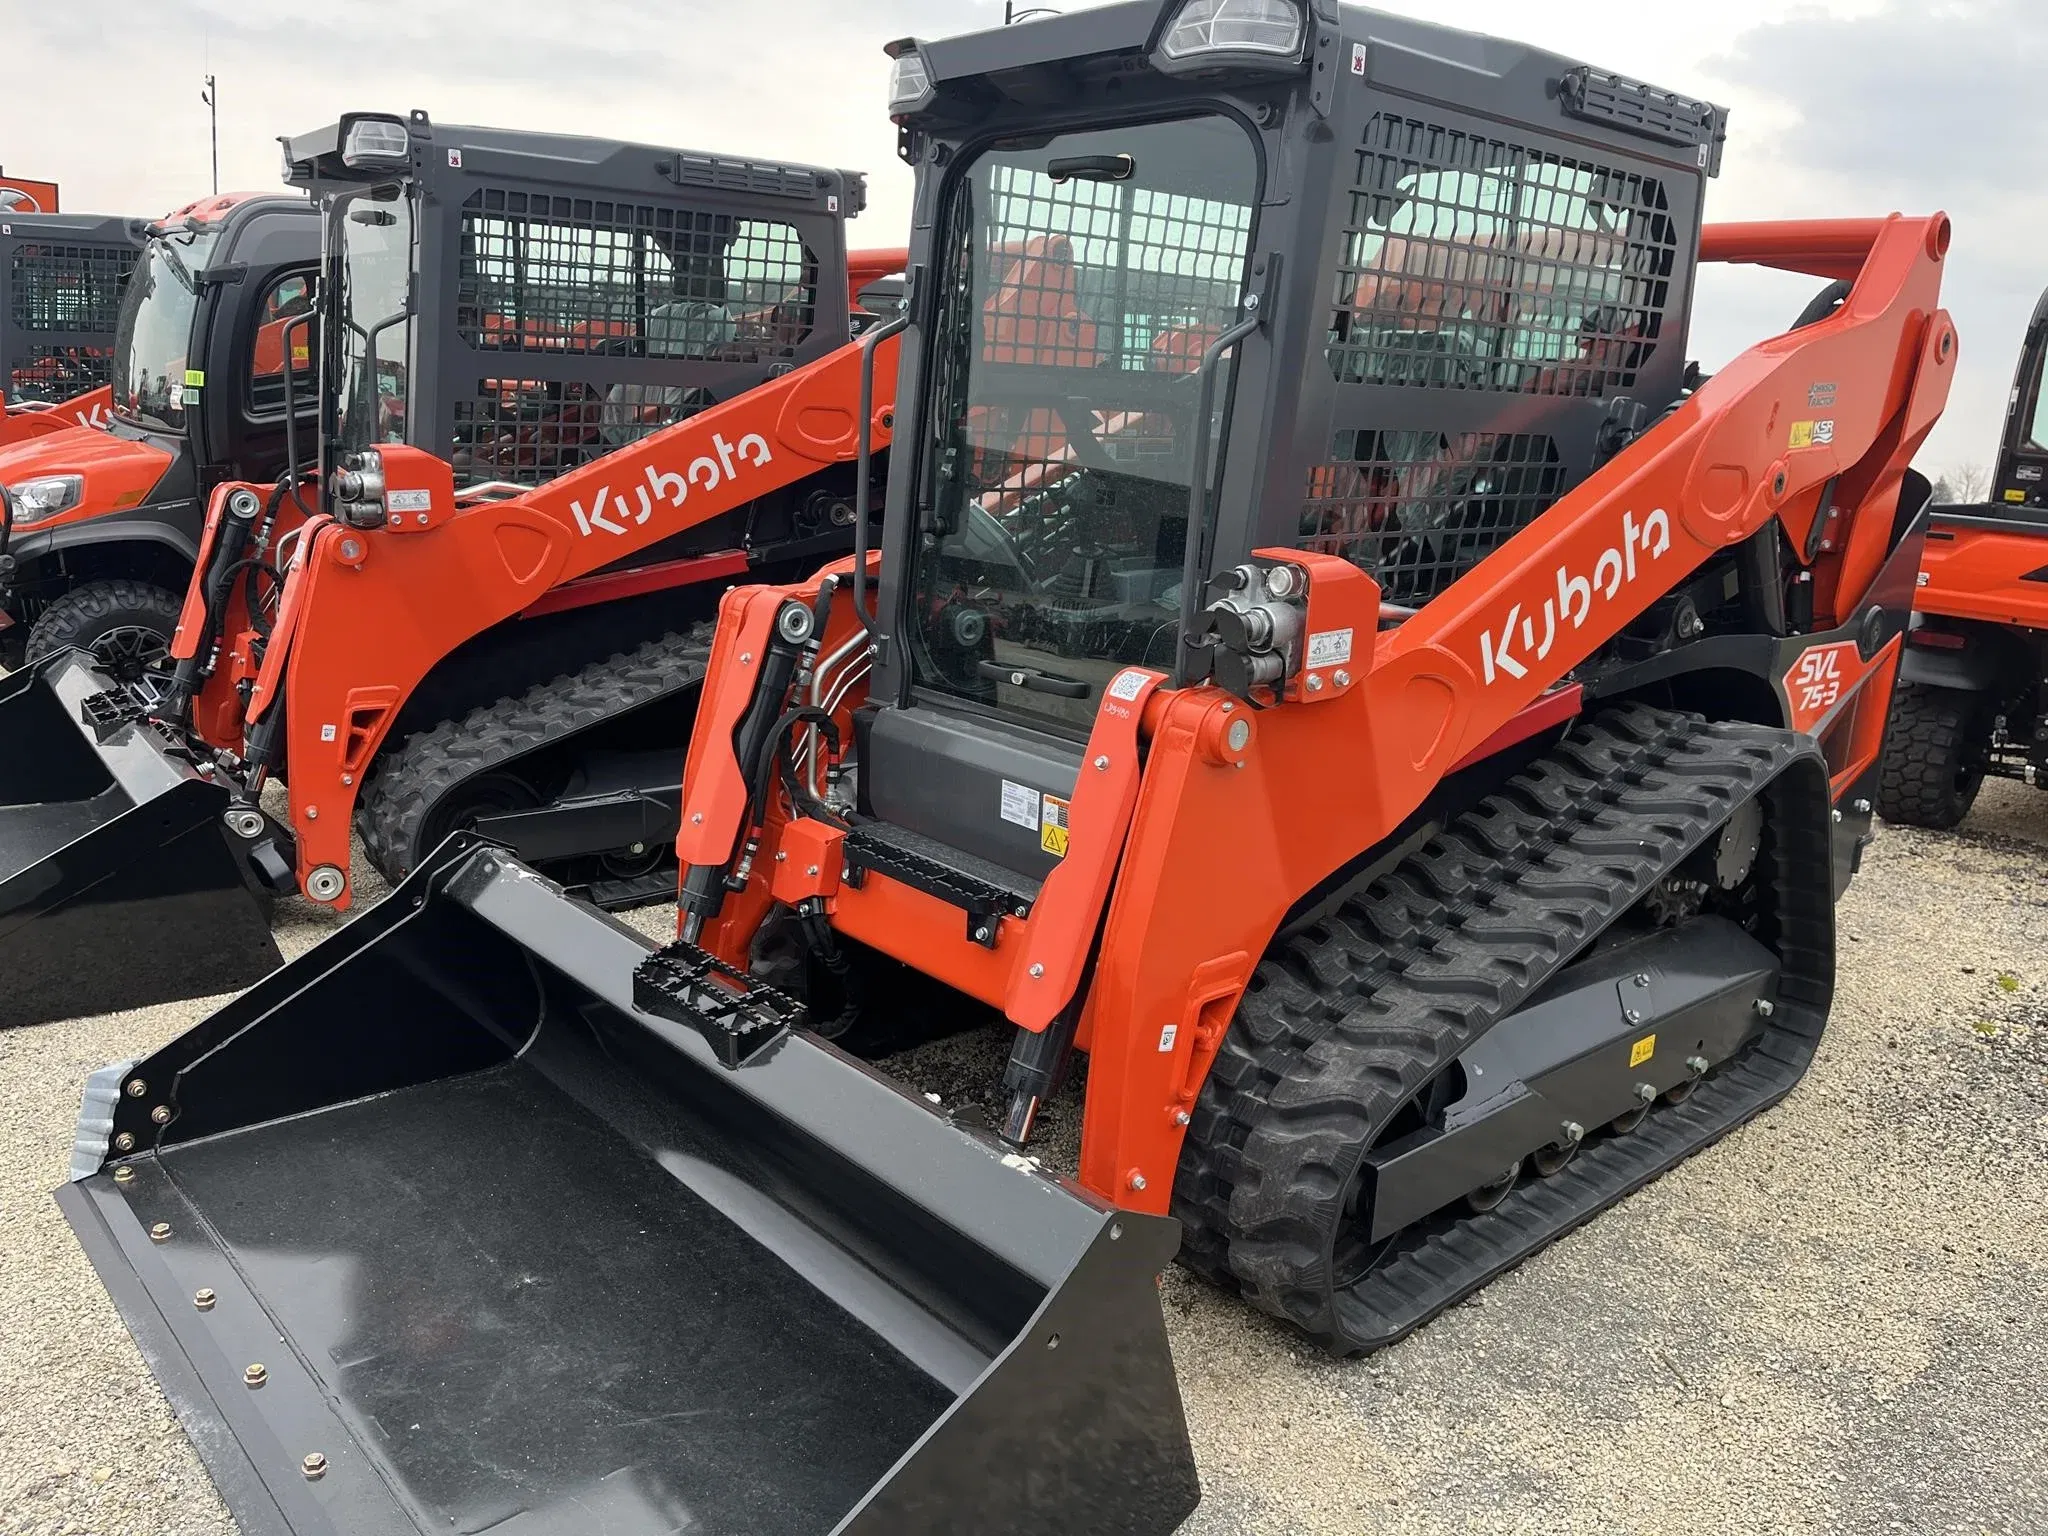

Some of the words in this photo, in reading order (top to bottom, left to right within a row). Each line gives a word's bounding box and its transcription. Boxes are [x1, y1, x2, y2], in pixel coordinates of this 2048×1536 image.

[1813, 420, 1834, 434] KSR
[570, 433, 772, 537] Kubota
[1480, 508, 1670, 686] Kubota
[1795, 650, 1841, 685] SVL
[1799, 681, 1840, 711] 75-3
